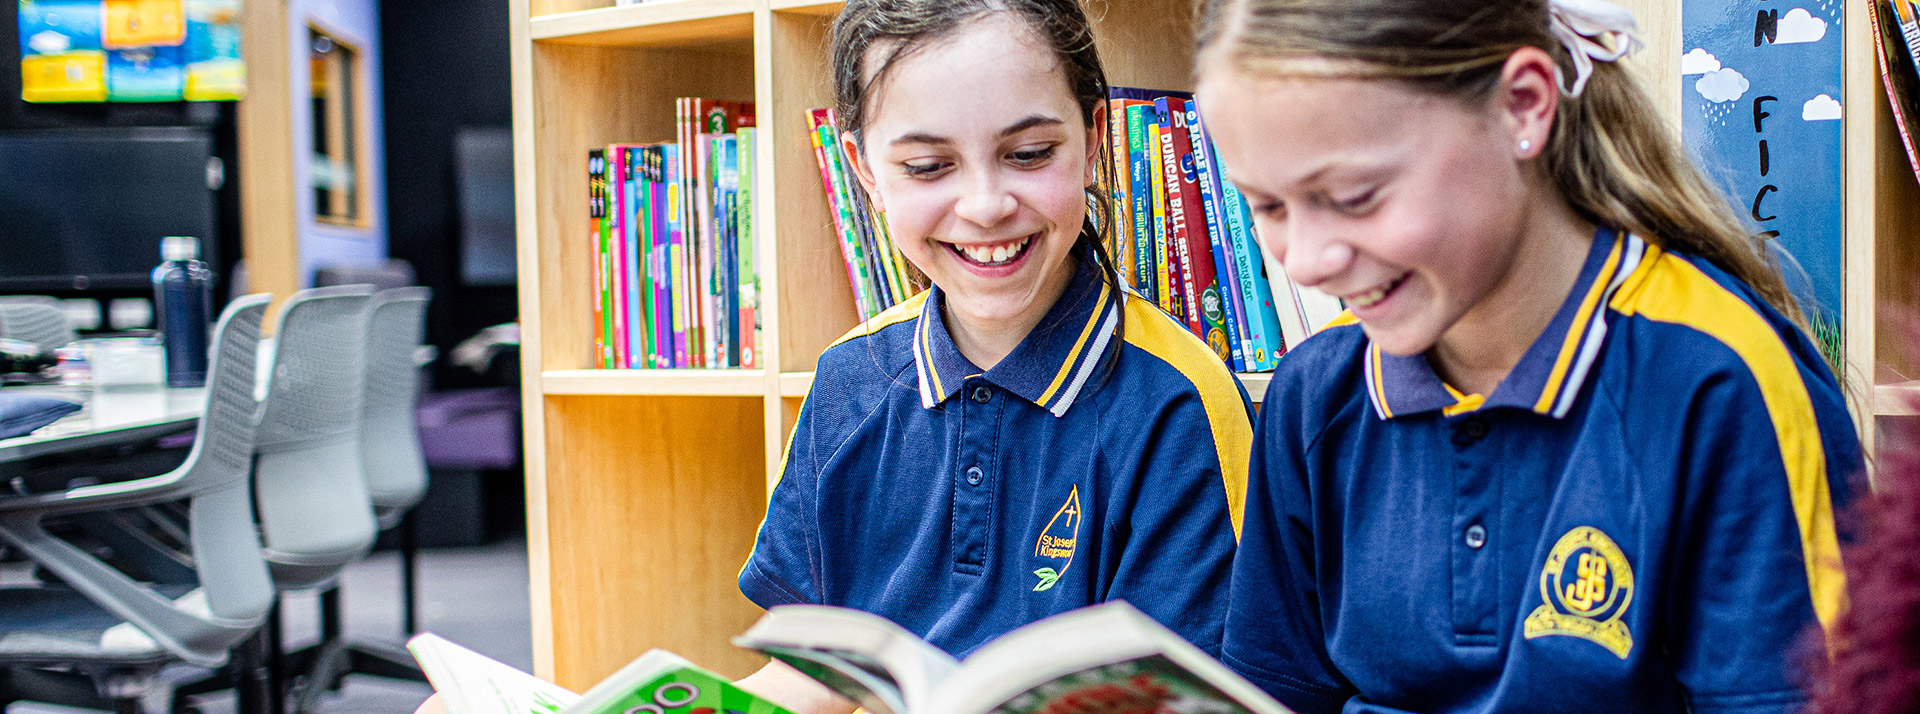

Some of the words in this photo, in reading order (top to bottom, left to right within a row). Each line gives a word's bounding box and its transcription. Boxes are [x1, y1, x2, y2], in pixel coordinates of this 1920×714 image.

[1754, 0, 1778, 47] N
[1172, 110, 1189, 129] DU
[1160, 132, 1181, 194] DUNCAN
[1189, 123, 1207, 170] BATTLE
[1199, 171, 1211, 195] BOY
[1170, 197, 1186, 233] BALL
[1204, 199, 1216, 224] OPEN
[1224, 187, 1239, 215] Strike
[1136, 212, 1146, 248] HAUNTED
[1155, 216, 1165, 241] DORK
[1209, 225, 1220, 247] FIRE
[1230, 217, 1238, 225] a
[1139, 248, 1147, 283] MUSEUM
[1178, 237, 1192, 281] SELBY'S
[1184, 281, 1199, 323] SECRET
[1243, 280, 1254, 301] Star
[1222, 286, 1231, 316] CHARLIE
[1228, 318, 1237, 346] CARTER
[1042, 535, 1053, 546] St
